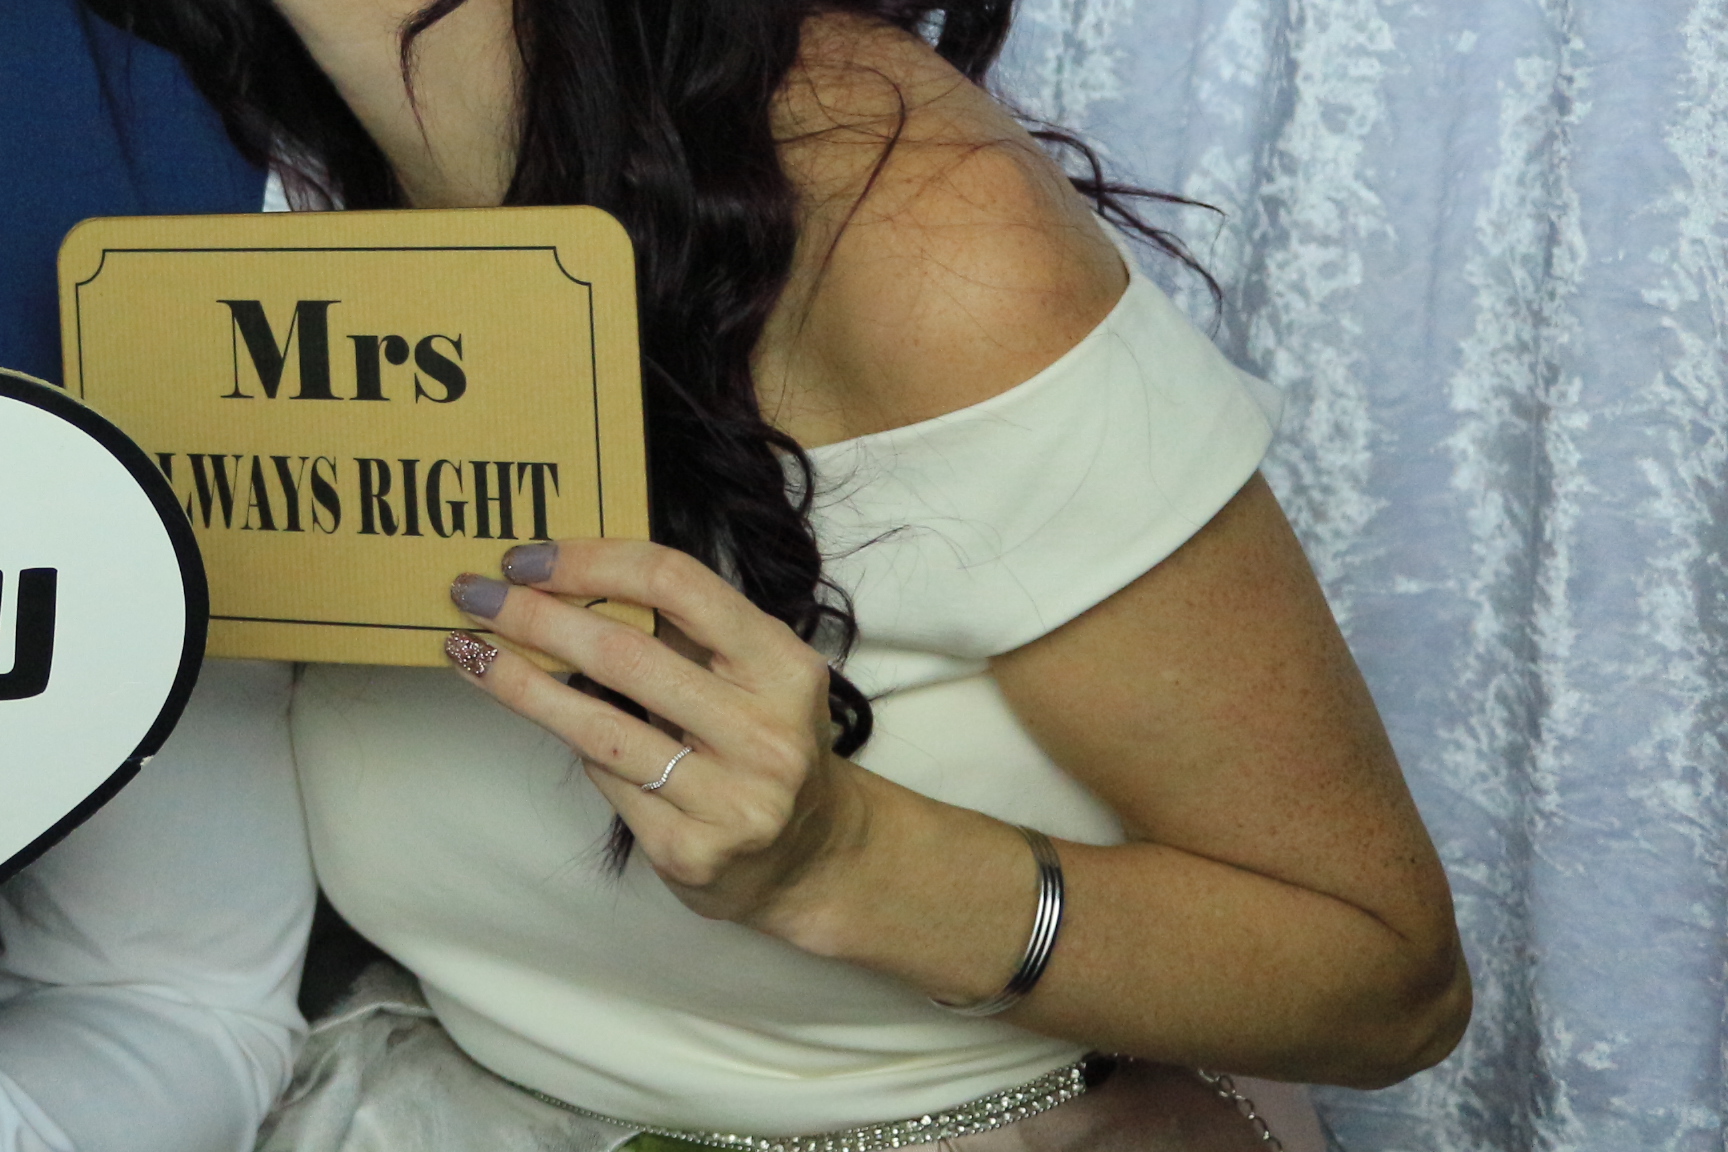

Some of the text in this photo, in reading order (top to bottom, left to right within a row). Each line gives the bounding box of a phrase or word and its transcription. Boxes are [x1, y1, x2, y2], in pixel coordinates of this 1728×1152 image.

[215, 299, 467, 404] Mrs
[154, 452, 560, 541] WAYS RIGHT
